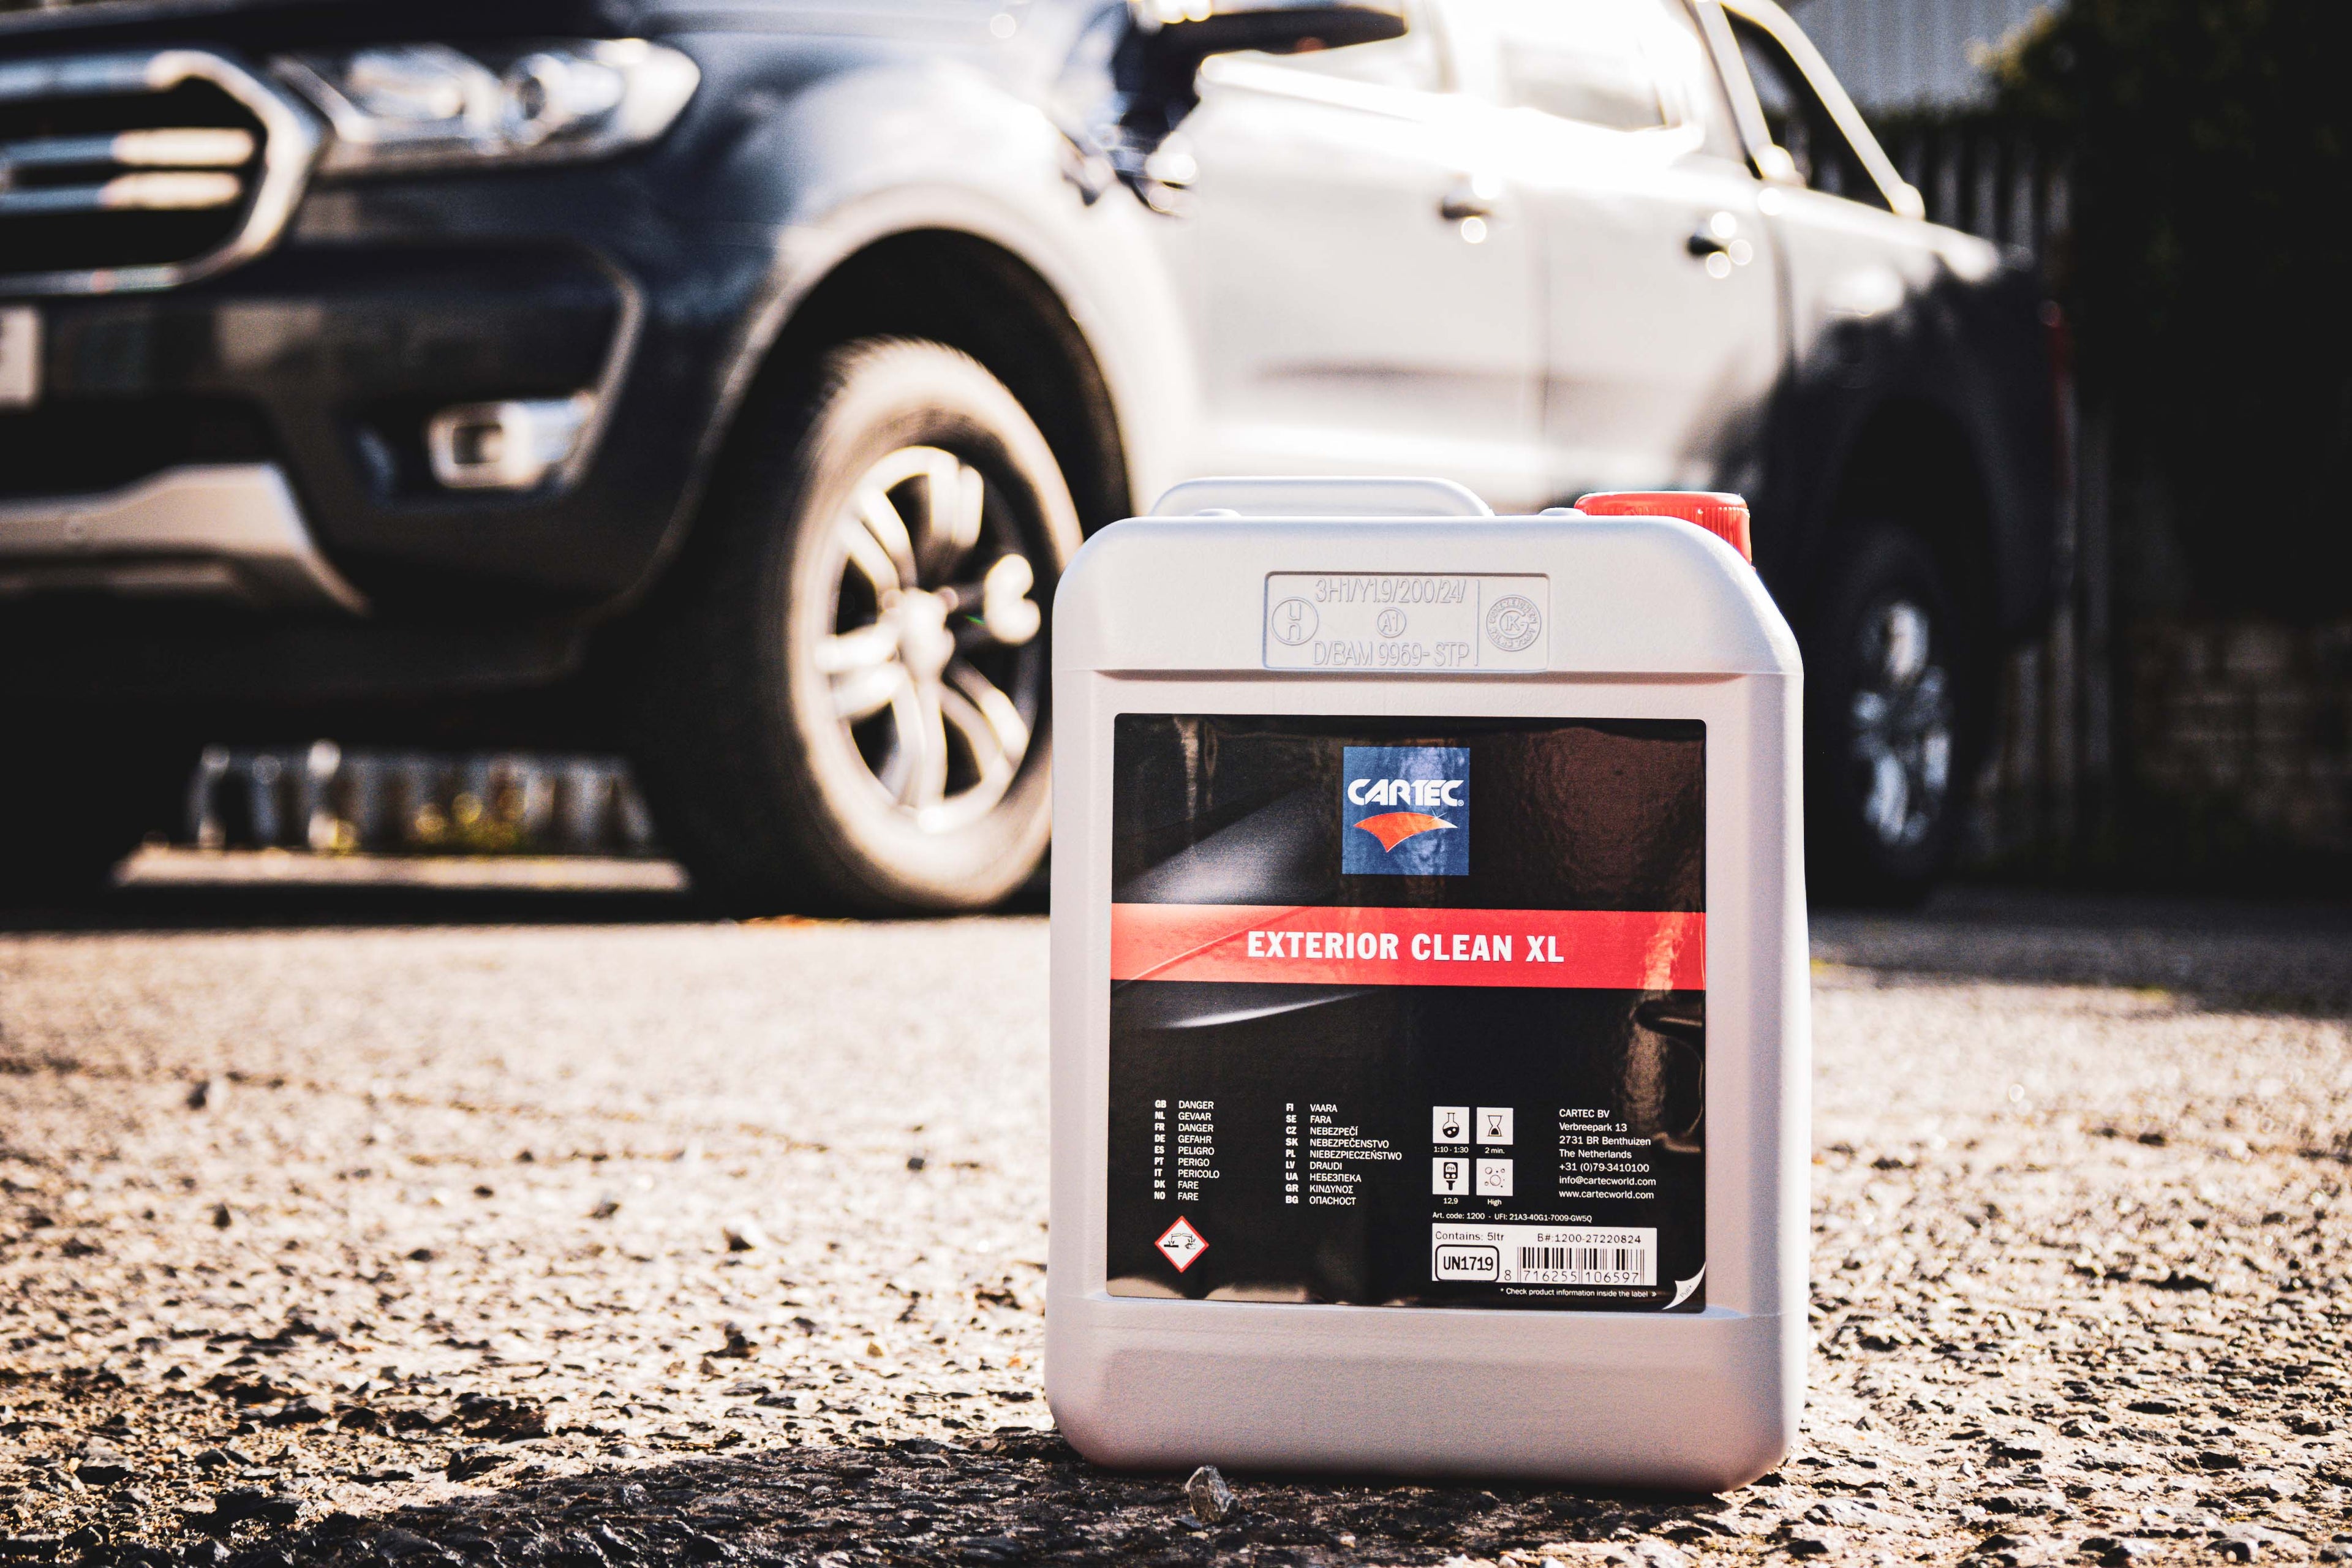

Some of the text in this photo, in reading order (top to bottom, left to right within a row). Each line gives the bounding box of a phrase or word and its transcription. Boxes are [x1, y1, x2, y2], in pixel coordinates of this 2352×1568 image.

[1313, 641, 1374, 666] D/BAM
[1434, 642, 1470, 668] STP
[1248, 931, 1564, 962] EXTERIOR CLEAN XL
[1178, 1101, 1214, 1109] DANGER
[1286, 1103, 1338, 1113] FI VAARA
[1178, 1112, 1212, 1121] GEVAAR
[1559, 1109, 1610, 1118] CARTEC BV
[1310, 1115, 1332, 1124] FARA
[1155, 1123, 1214, 1133] FR DANGER
[1310, 1126, 1359, 1136] NEBEZPEČÍ
[1559, 1122, 1627, 1133] Verbreepark 13
[1178, 1135, 1212, 1144] GEFAHR
[1310, 1138, 1390, 1148] NEBEZPEČENSTVO
[1559, 1136, 1584, 1144] 2731
[1602, 1137, 1651, 1145] Benthuizen
[1155, 1145, 1215, 1155] ES PELIGRO
[1559, 1149, 1632, 1159] The Netherlands
[1286, 1149, 1402, 1161] PL NIEBEZPIECZEŃSTWO
[1178, 1158, 1210, 1167] PERIGO
[1310, 1161, 1343, 1170] DRAUDI
[1559, 1163, 1649, 1172] +31 (0)79-3410100
[1178, 1169, 1220, 1178] PERICOLO
[1286, 1172, 1362, 1182] UA НЕБЕЗПЕКА
[1154, 1180, 1199, 1189] DK FARE
[1559, 1175, 1656, 1186] info@cartecworld.com
[1310, 1185, 1354, 1194] ΚΙΝΔΥΝΟΣ
[1154, 1191, 1166, 1200] NO
[1559, 1190, 1654, 1199] www.cartecworld.com
[1310, 1196, 1357, 1205] ОПАСНОСТ
[1435, 1231, 1504, 1241] Contains: 5ltr
[1443, 1256, 1494, 1272] UN1719
[1504, 1269, 1639, 1283] 8 716255 106597
